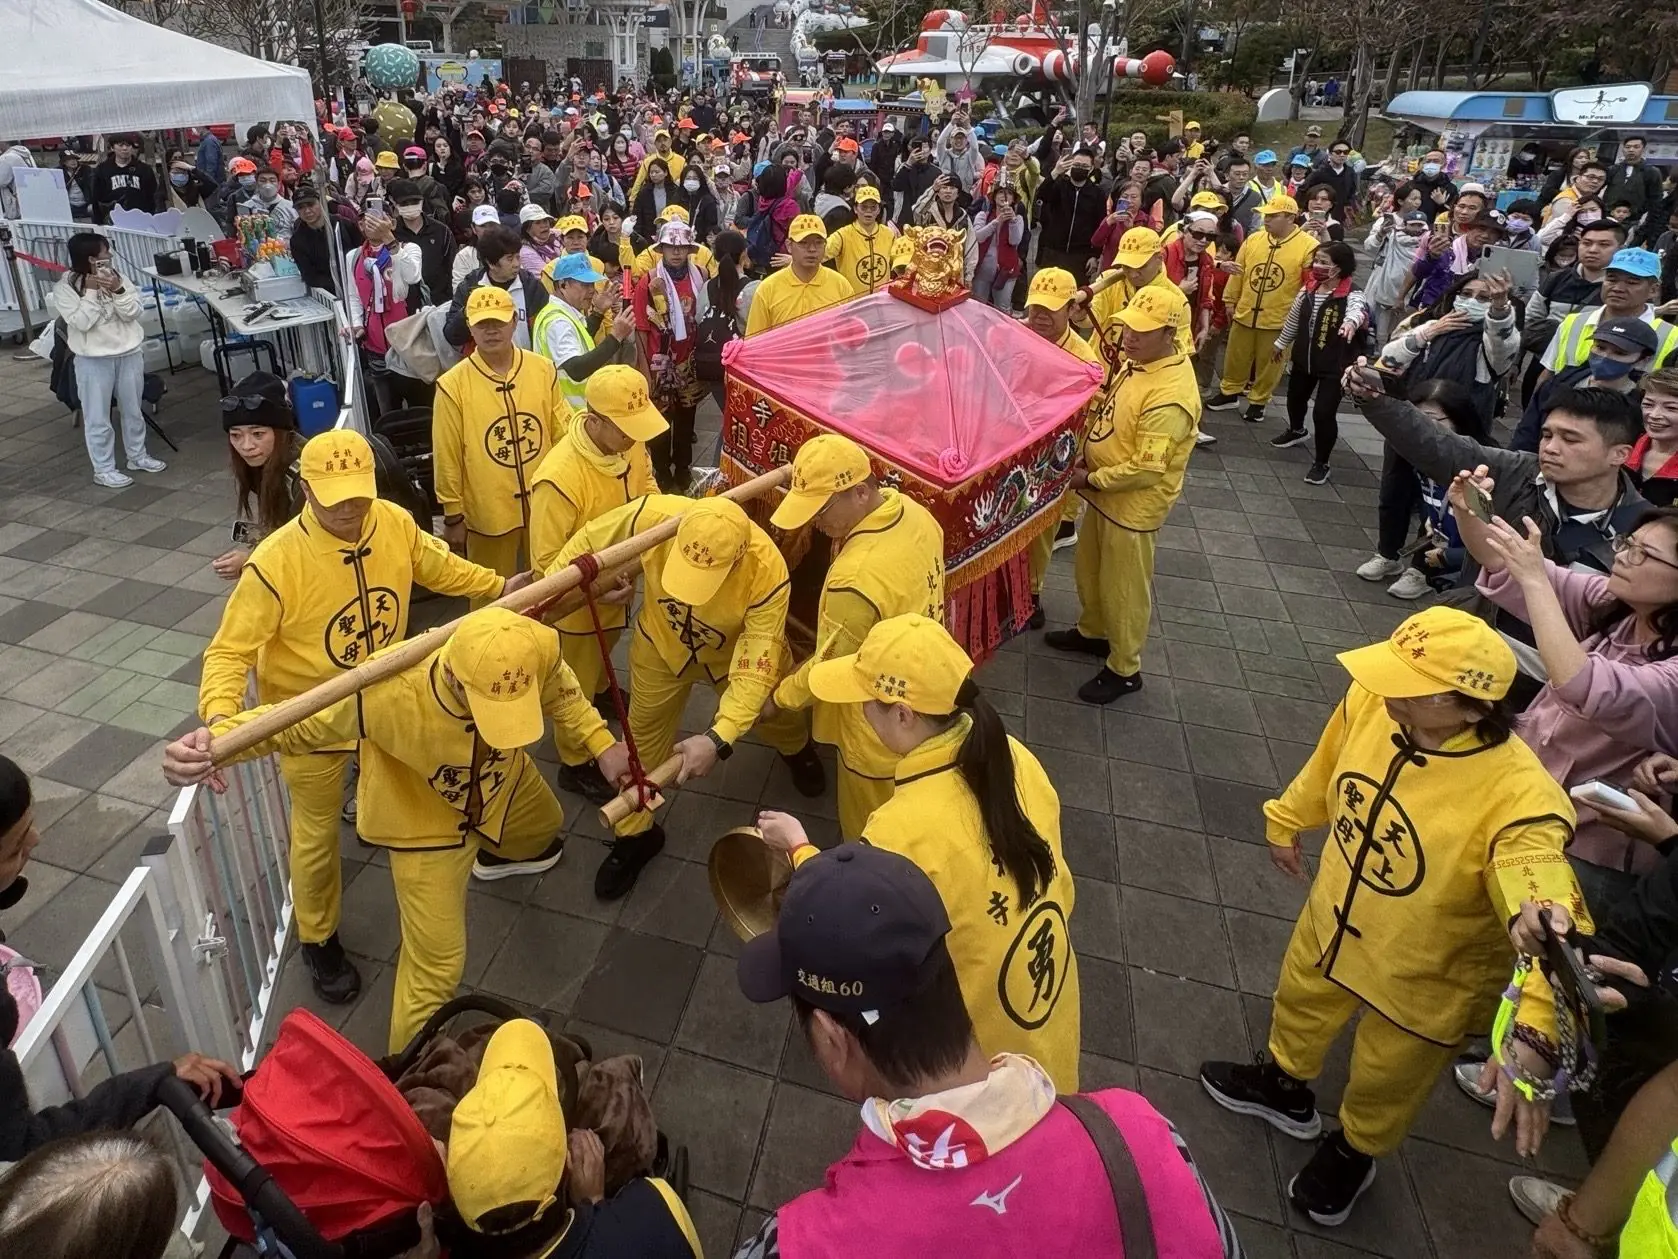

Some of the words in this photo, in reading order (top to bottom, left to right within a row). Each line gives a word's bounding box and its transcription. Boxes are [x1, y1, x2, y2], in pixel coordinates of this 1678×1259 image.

[333, 449, 352, 458] 台北
[493, 425, 511, 461] 聖母
[522, 418, 538, 454] 天上
[338, 614, 361, 662] 聖母
[376, 593, 391, 645] 天上
[1336, 780, 1365, 844] 聖母
[1371, 820, 1407, 888] 天上
